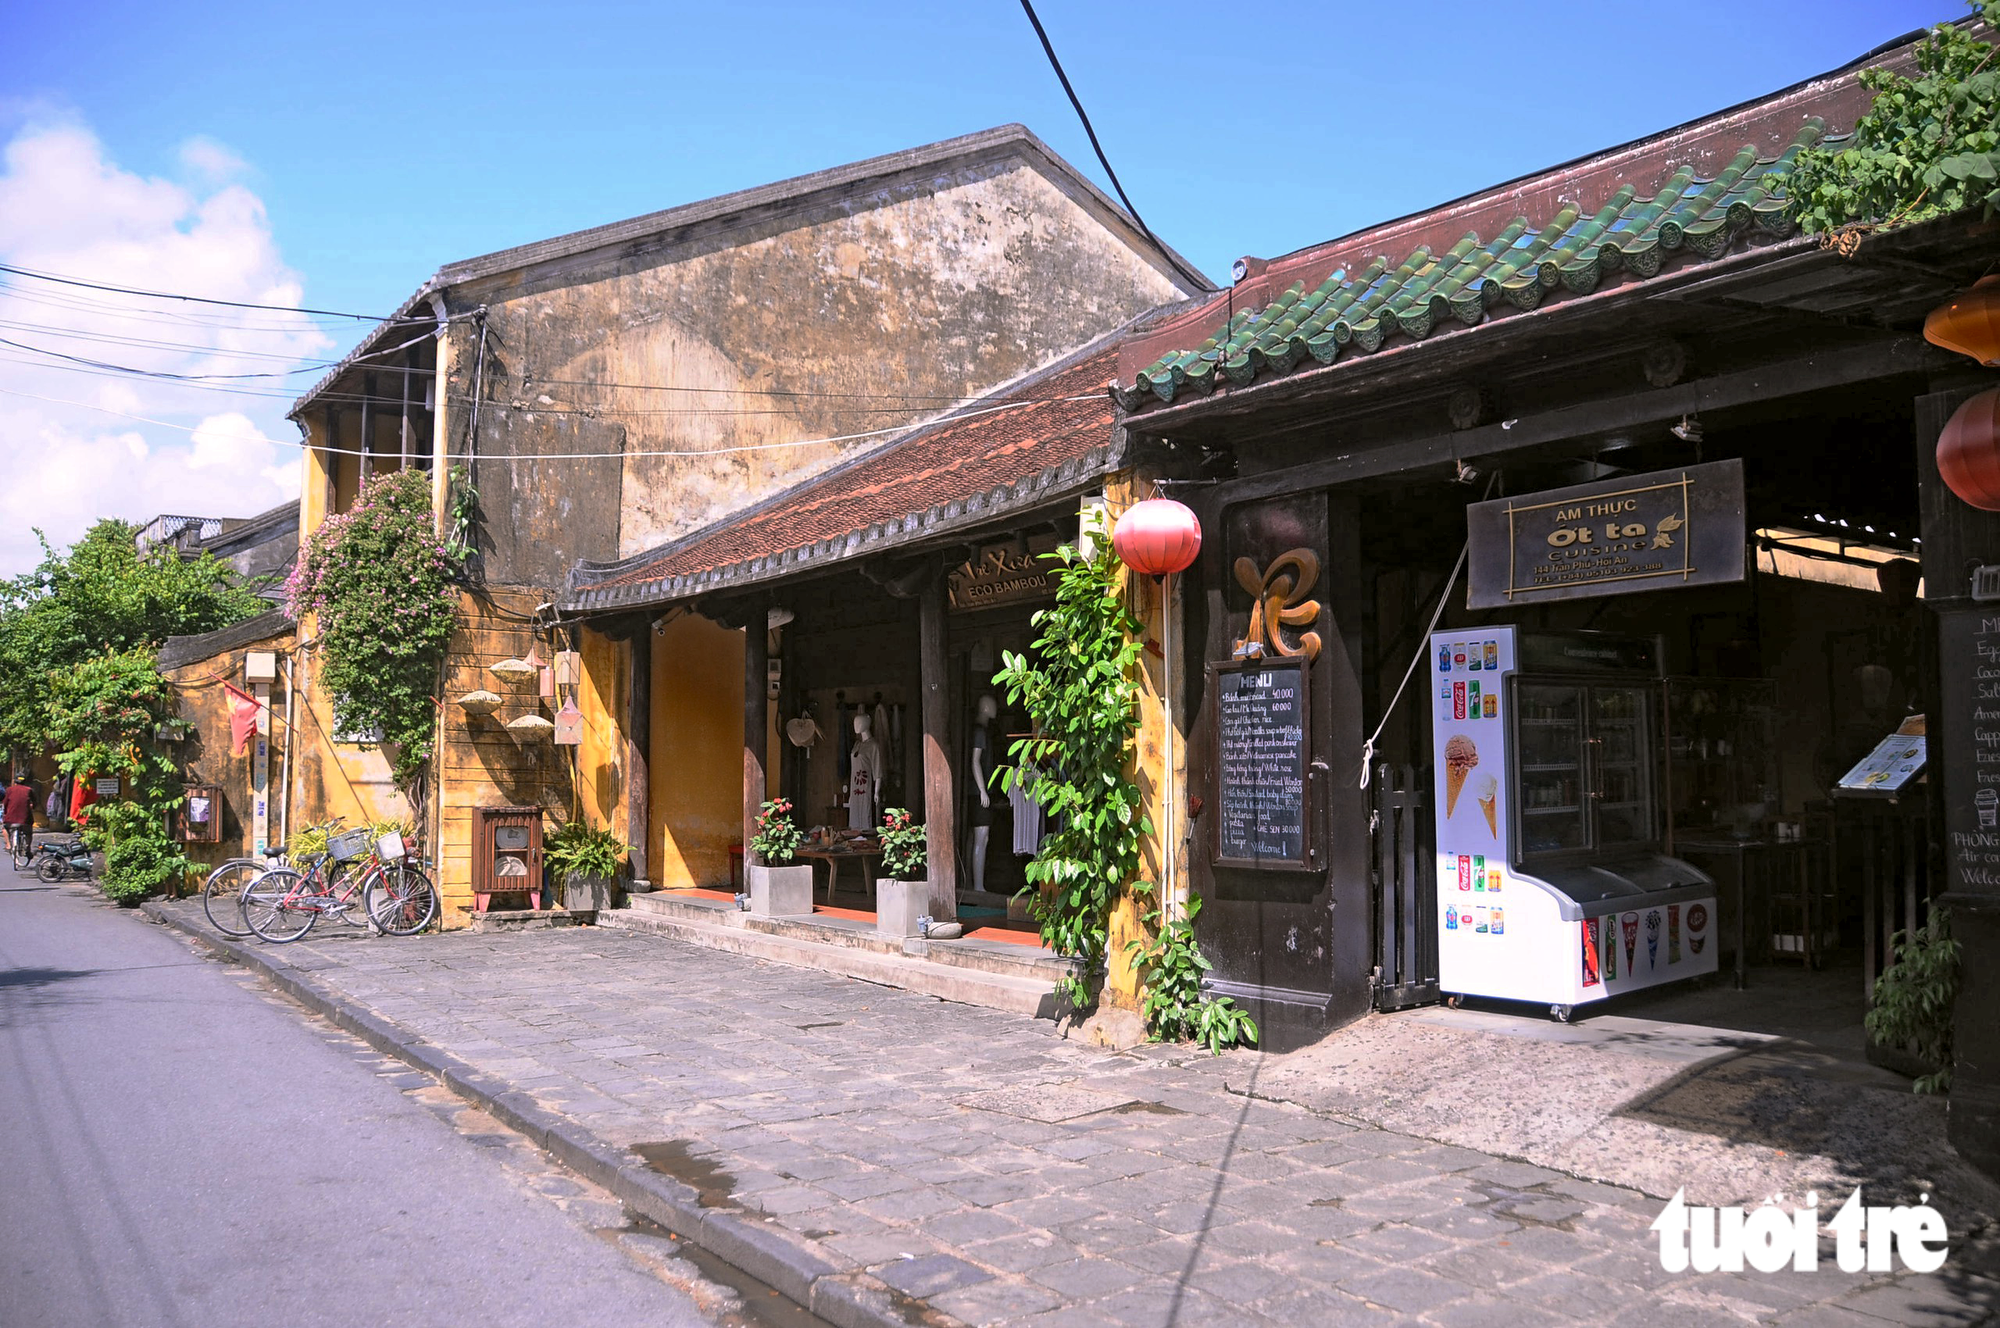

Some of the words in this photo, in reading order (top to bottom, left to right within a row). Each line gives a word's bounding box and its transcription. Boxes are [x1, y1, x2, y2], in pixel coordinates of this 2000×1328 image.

[1586, 499, 1637, 518] THỰC
[1606, 523, 1647, 540] ta
[968, 584, 993, 598] ECO
[994, 575, 1048, 595] BAMBOU
[1241, 673, 1272, 688] MENU
